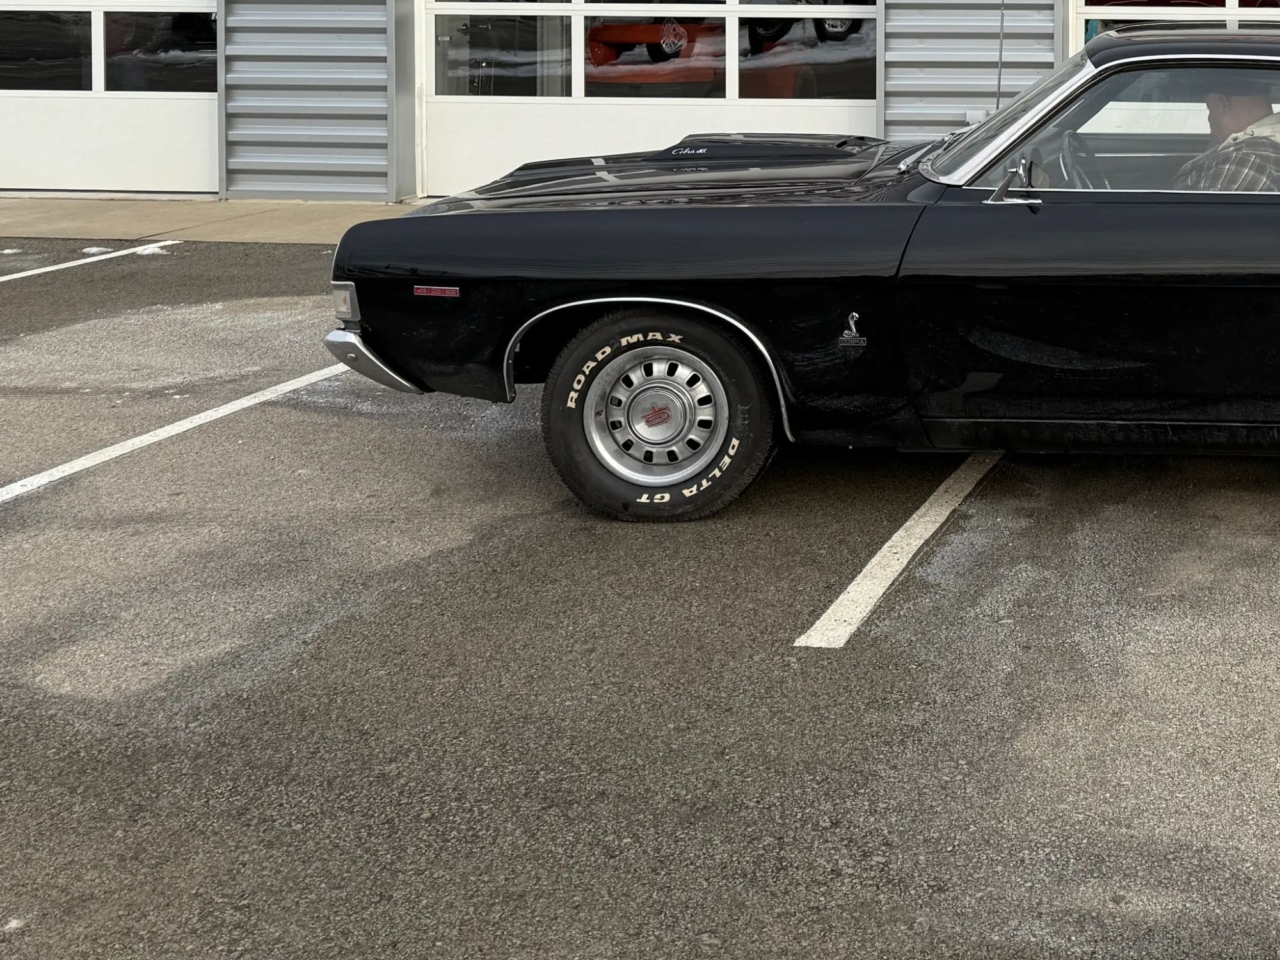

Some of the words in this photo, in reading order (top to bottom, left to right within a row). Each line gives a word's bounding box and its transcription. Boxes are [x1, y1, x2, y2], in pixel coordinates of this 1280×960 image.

[567, 345, 612, 409] ROAD
[620, 332, 684, 347] MAX
[636, 493, 671, 503] GT
[682, 437, 740, 498] DELTA
